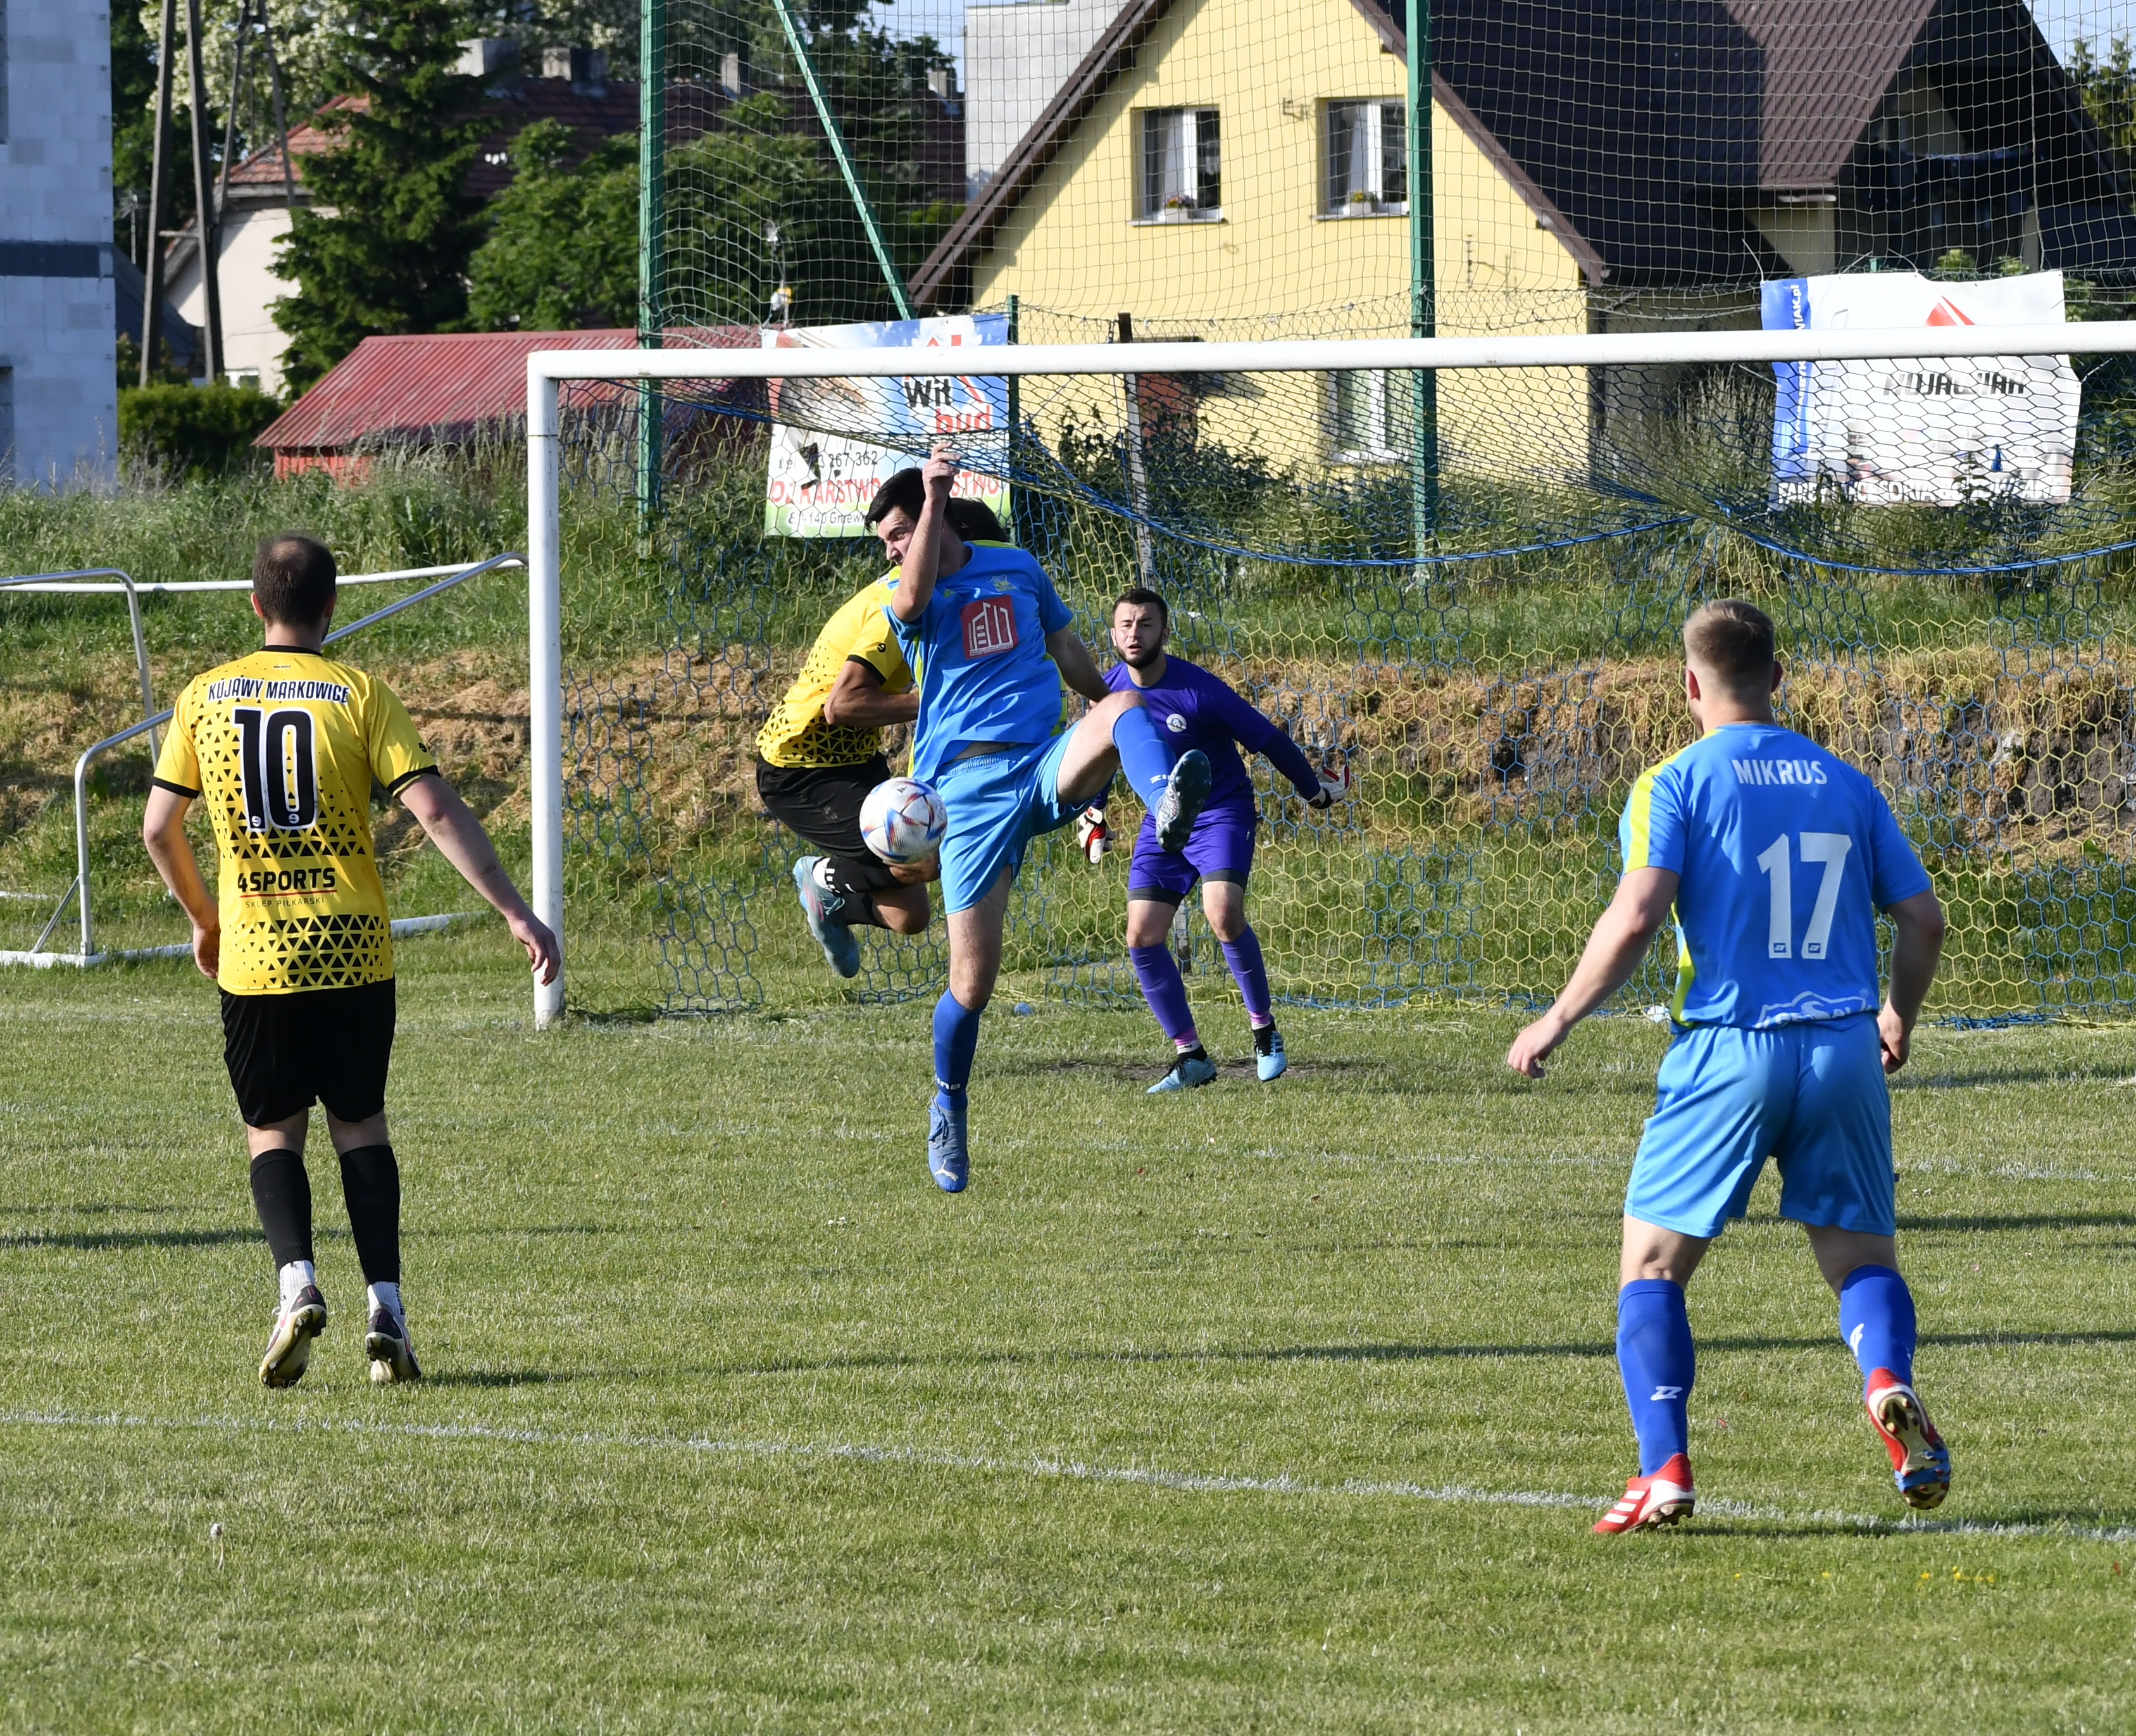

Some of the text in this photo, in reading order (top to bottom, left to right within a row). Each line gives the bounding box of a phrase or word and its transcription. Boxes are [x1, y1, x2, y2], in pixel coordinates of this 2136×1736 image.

[904, 378, 951, 408] Wit
[935, 405, 990, 434] bud
[856, 450, 878, 466] 362
[788, 511, 826, 525] 8-140
[208, 678, 350, 703] KUJAWY MARKOWICE
[233, 707, 315, 830] 10
[1732, 759, 1828, 785] MIKRUS
[237, 867, 335, 892] 4SPORTS
[246, 897, 325, 909] SKLEP PIŁKARSKI
[1756, 831, 1852, 960] 17
